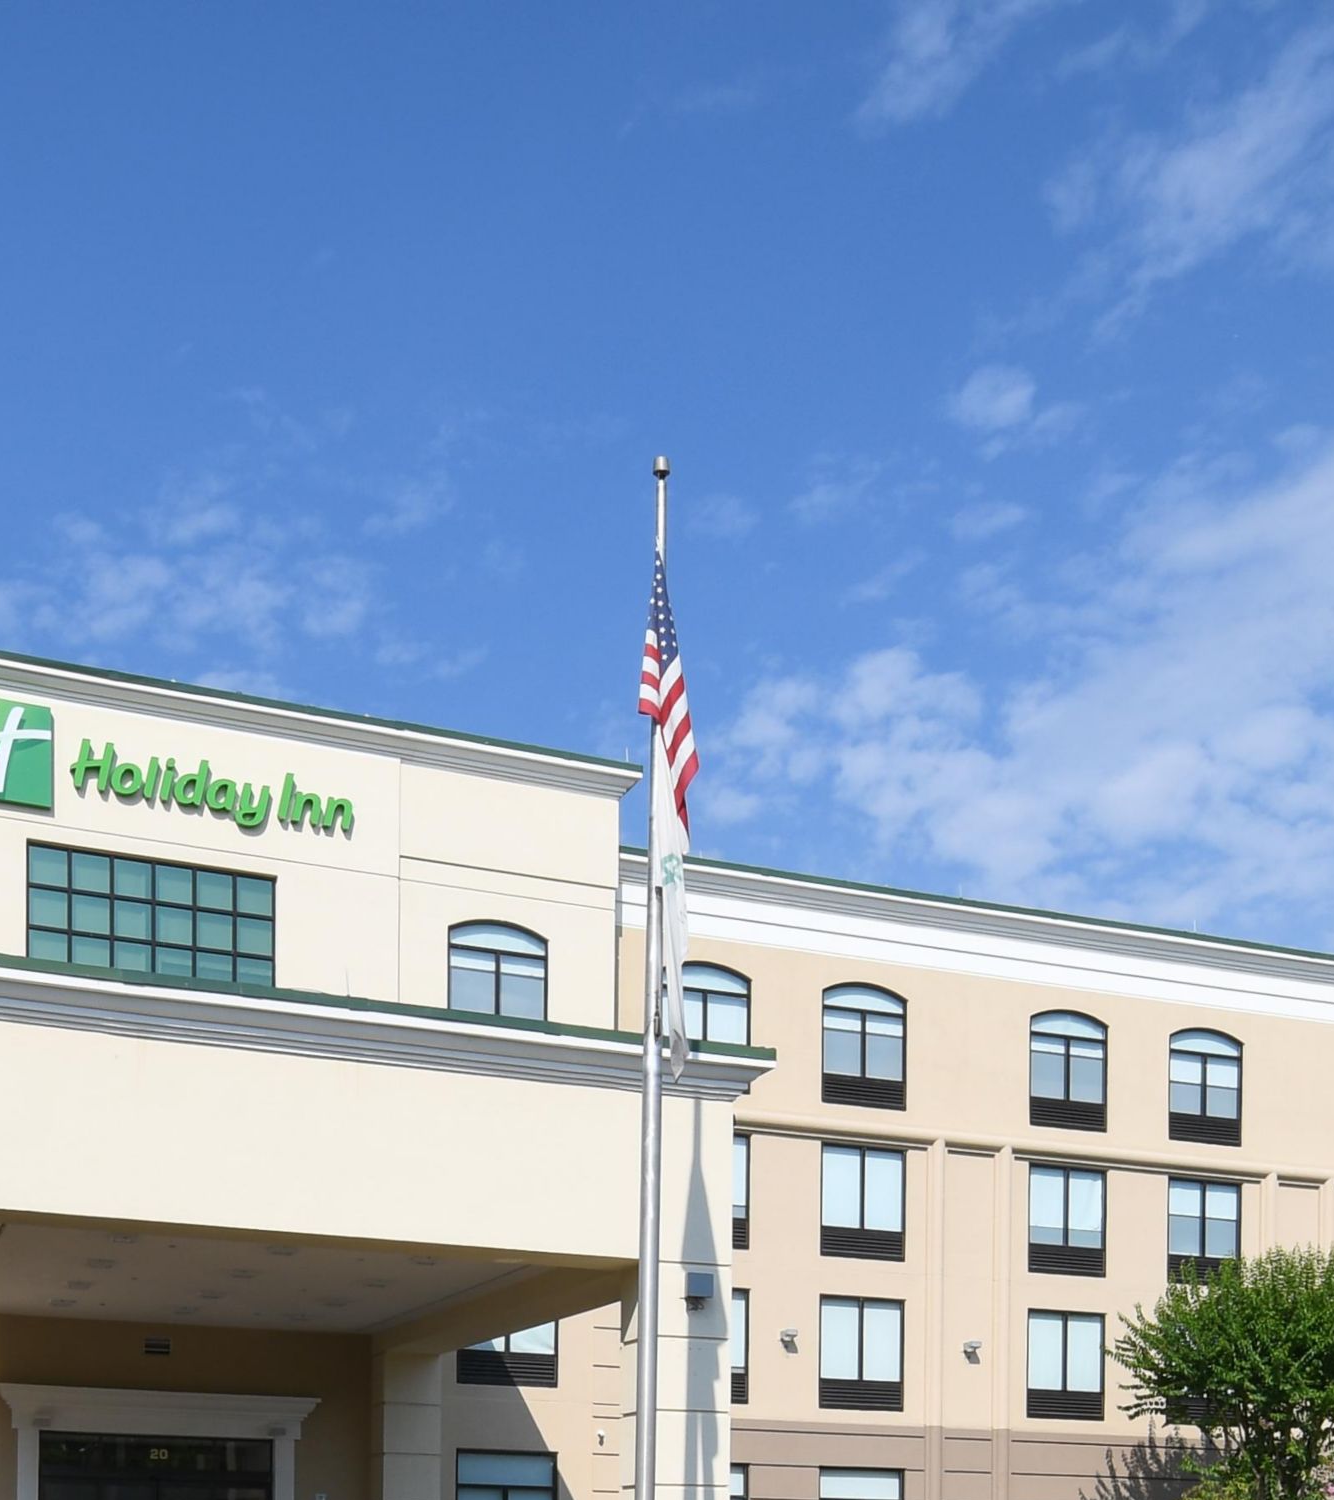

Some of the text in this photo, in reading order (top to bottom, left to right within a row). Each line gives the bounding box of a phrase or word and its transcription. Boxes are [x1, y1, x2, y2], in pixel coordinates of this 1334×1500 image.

[70, 738, 354, 832] Holiday Inn
[150, 1449, 169, 1460] 20
